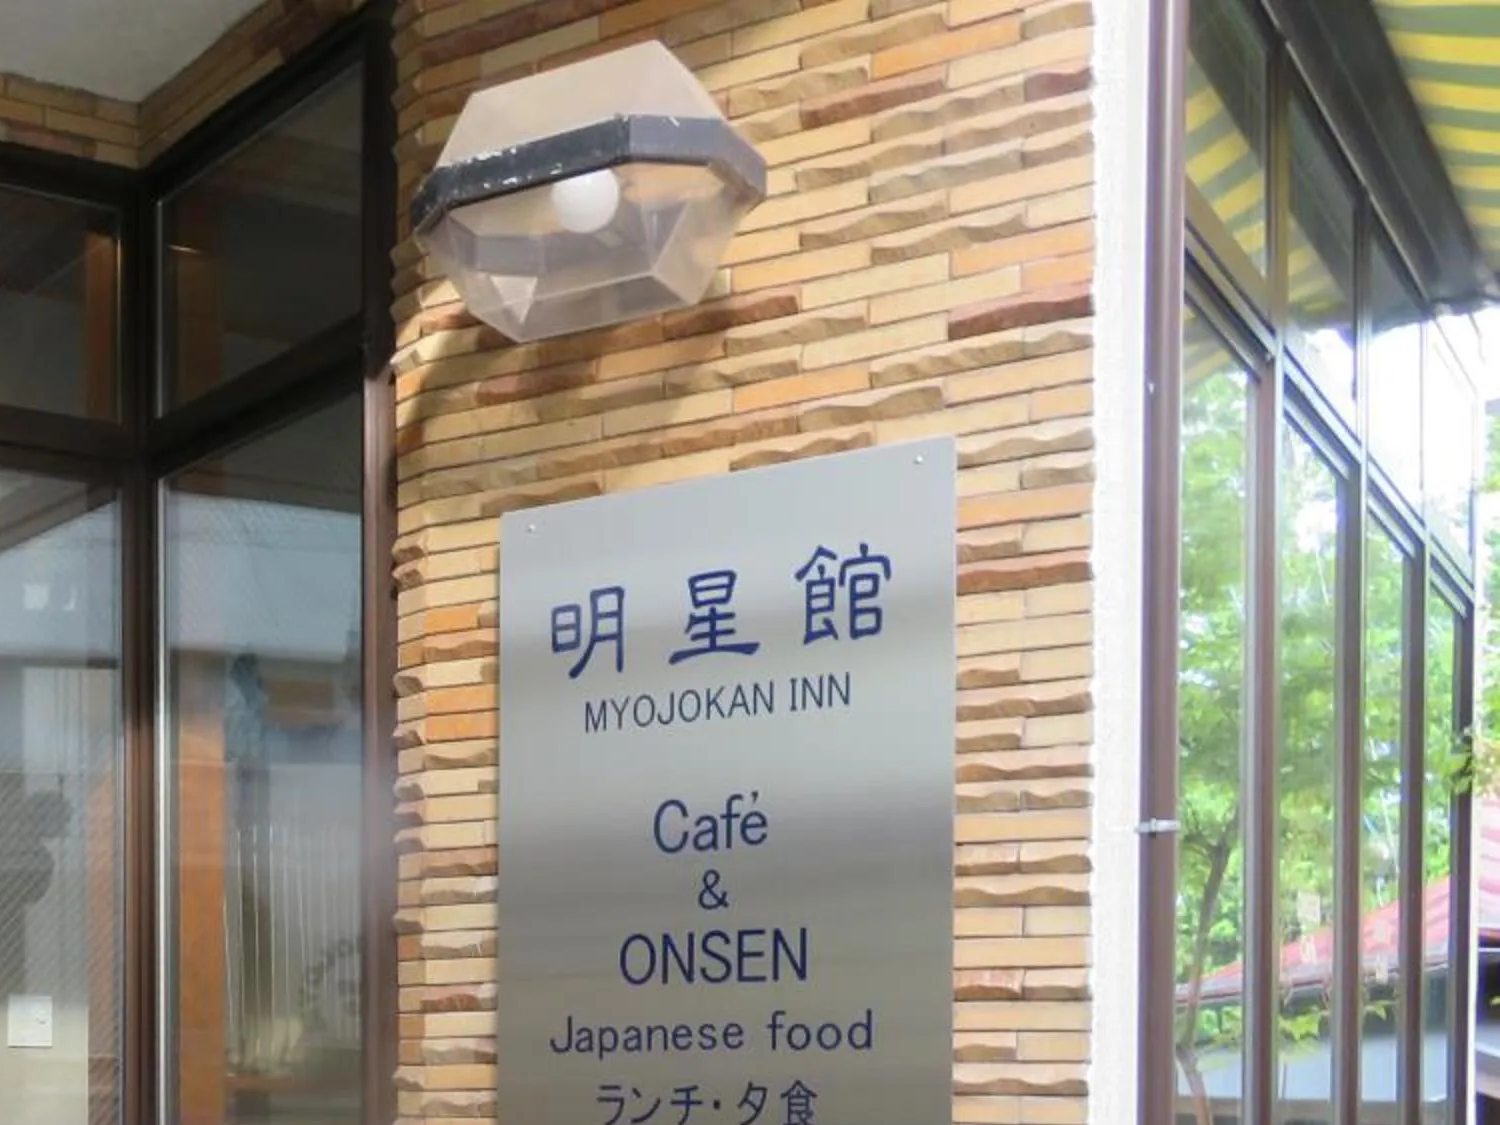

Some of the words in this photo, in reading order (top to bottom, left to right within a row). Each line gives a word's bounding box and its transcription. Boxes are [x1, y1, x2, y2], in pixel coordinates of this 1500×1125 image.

[551, 542, 892, 679] 明星館
[584, 681, 775, 734] MYOJOKAN
[789, 671, 852, 713] INN
[652, 790, 769, 854] Café
[697, 869, 730, 910] &
[619, 927, 808, 985] ONSEN
[549, 1015, 745, 1060] Japanese
[766, 1008, 874, 1052] food
